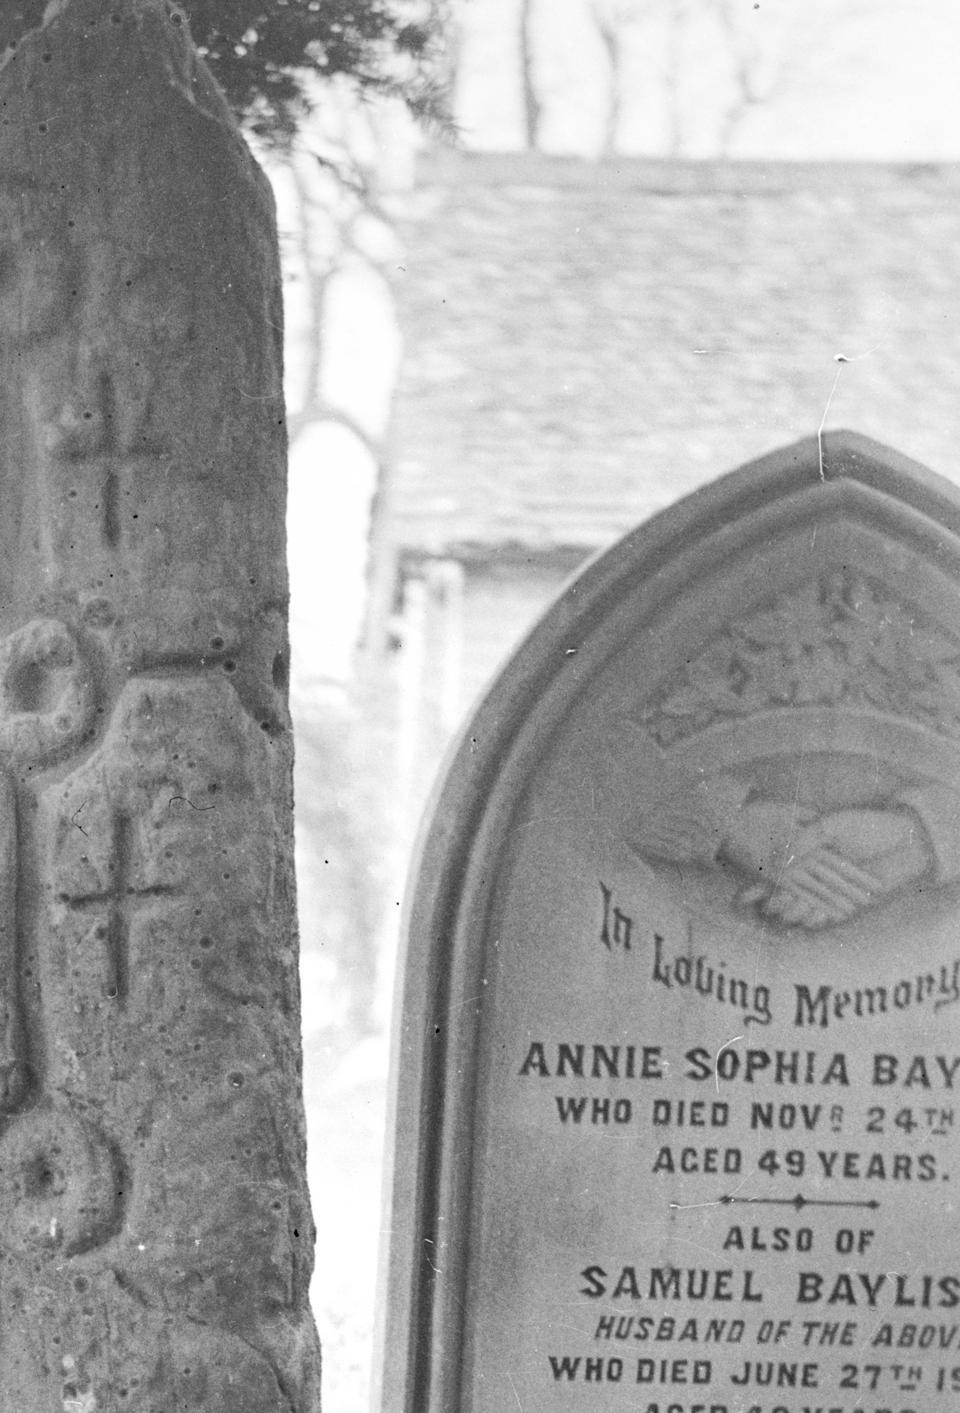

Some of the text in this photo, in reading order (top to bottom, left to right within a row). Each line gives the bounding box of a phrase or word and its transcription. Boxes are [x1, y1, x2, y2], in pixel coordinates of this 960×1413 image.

[599, 880, 960, 1028] In Loving Memory
[518, 1042, 664, 1080] ANNIE
[685, 1046, 850, 1087] SOPHIA
[554, 1096, 633, 1126] WHO
[652, 1100, 729, 1128] DIED
[866, 1106, 954, 1136] 24TH
[652, 1146, 950, 1182] AGED 49 YEARS.
[723, 1226, 875, 1254] ALSO OF
[579, 1265, 960, 1309] SAMUEL BAYLIS
[594, 1315, 960, 1350] HUSBAND OF THE ABOV
[548, 1355, 624, 1384] WHO
[636, 1359, 712, 1385] DIED
[730, 1362, 819, 1389] JUNE
[840, 1364, 922, 1391] 27TH
